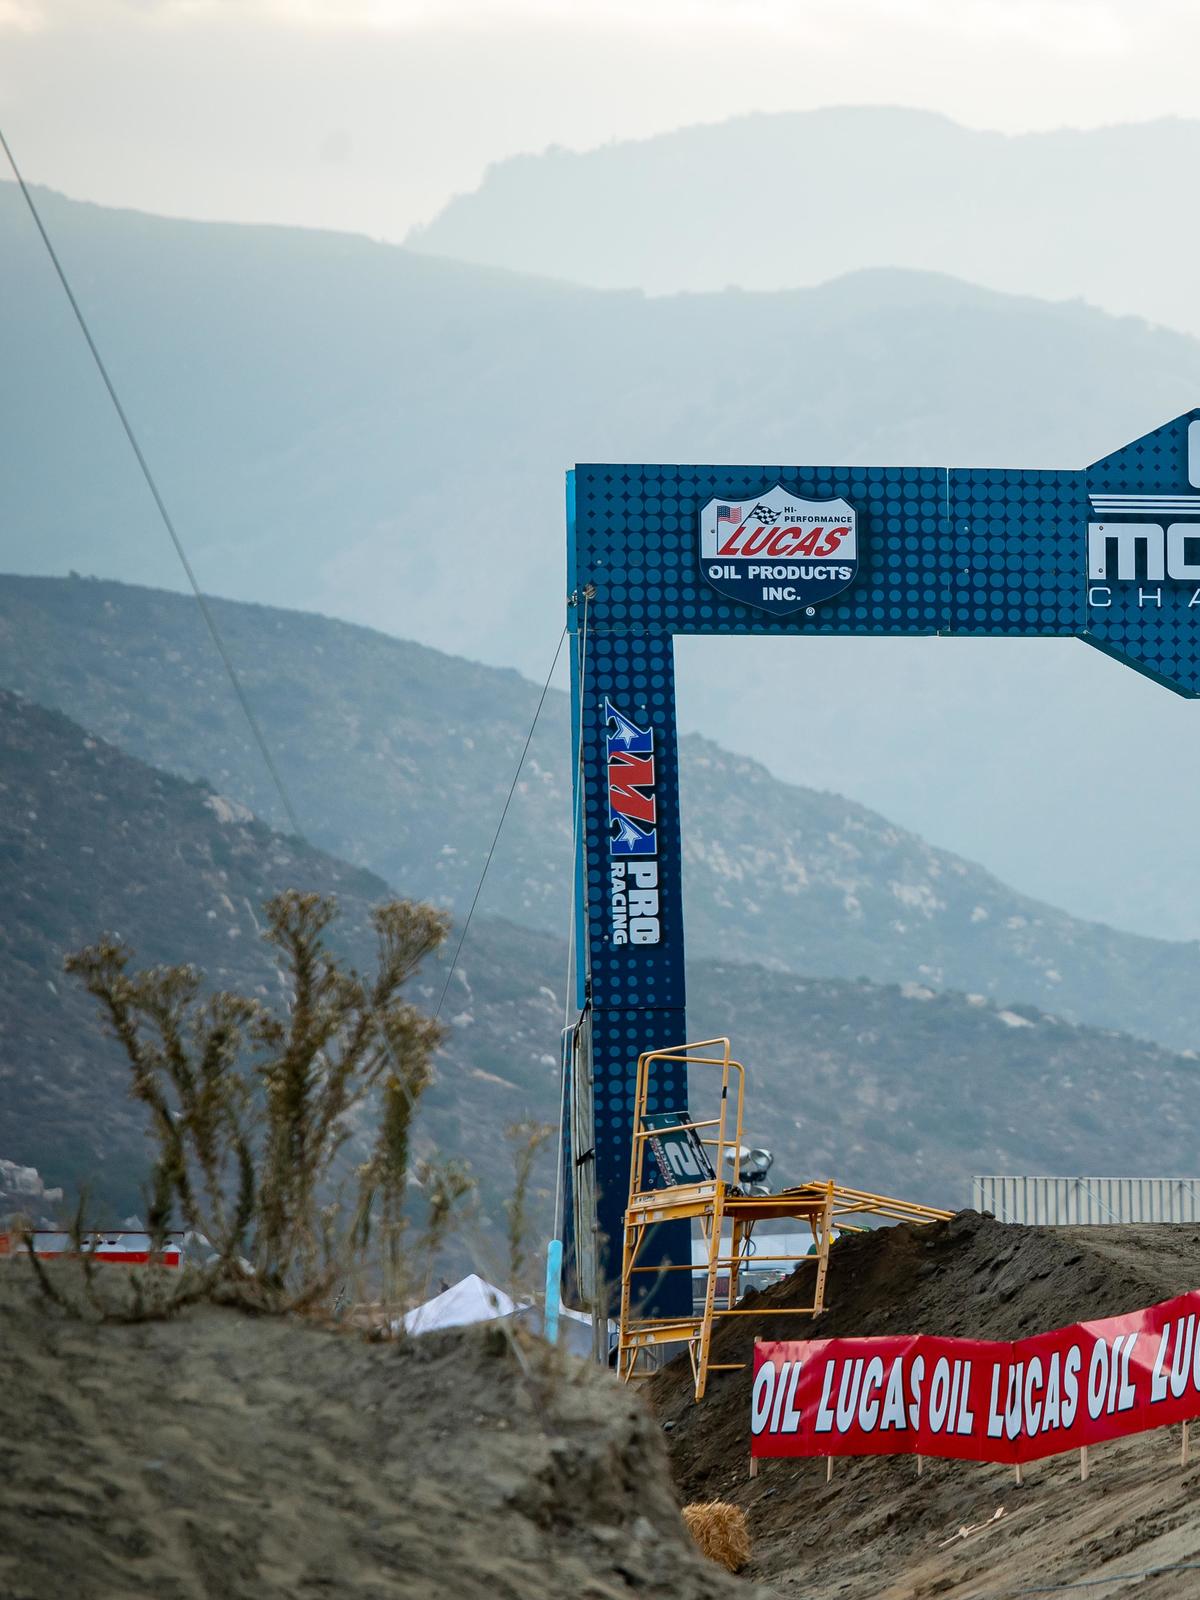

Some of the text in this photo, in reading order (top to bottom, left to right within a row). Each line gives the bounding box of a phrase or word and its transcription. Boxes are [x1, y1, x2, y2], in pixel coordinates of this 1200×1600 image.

[718, 526, 850, 557] LUCAS
[708, 565, 852, 580] OIL PRODUCTS
[762, 587, 801, 601] INC.
[610, 862, 628, 945] RACING
[627, 861, 660, 945] PRO
[751, 1359, 802, 1436] OIL
[814, 1353, 925, 1434] LUCAS
[928, 1355, 975, 1436] OIL
[987, 1344, 1082, 1441] LUCAS
[1087, 1331, 1138, 1420] OIL
